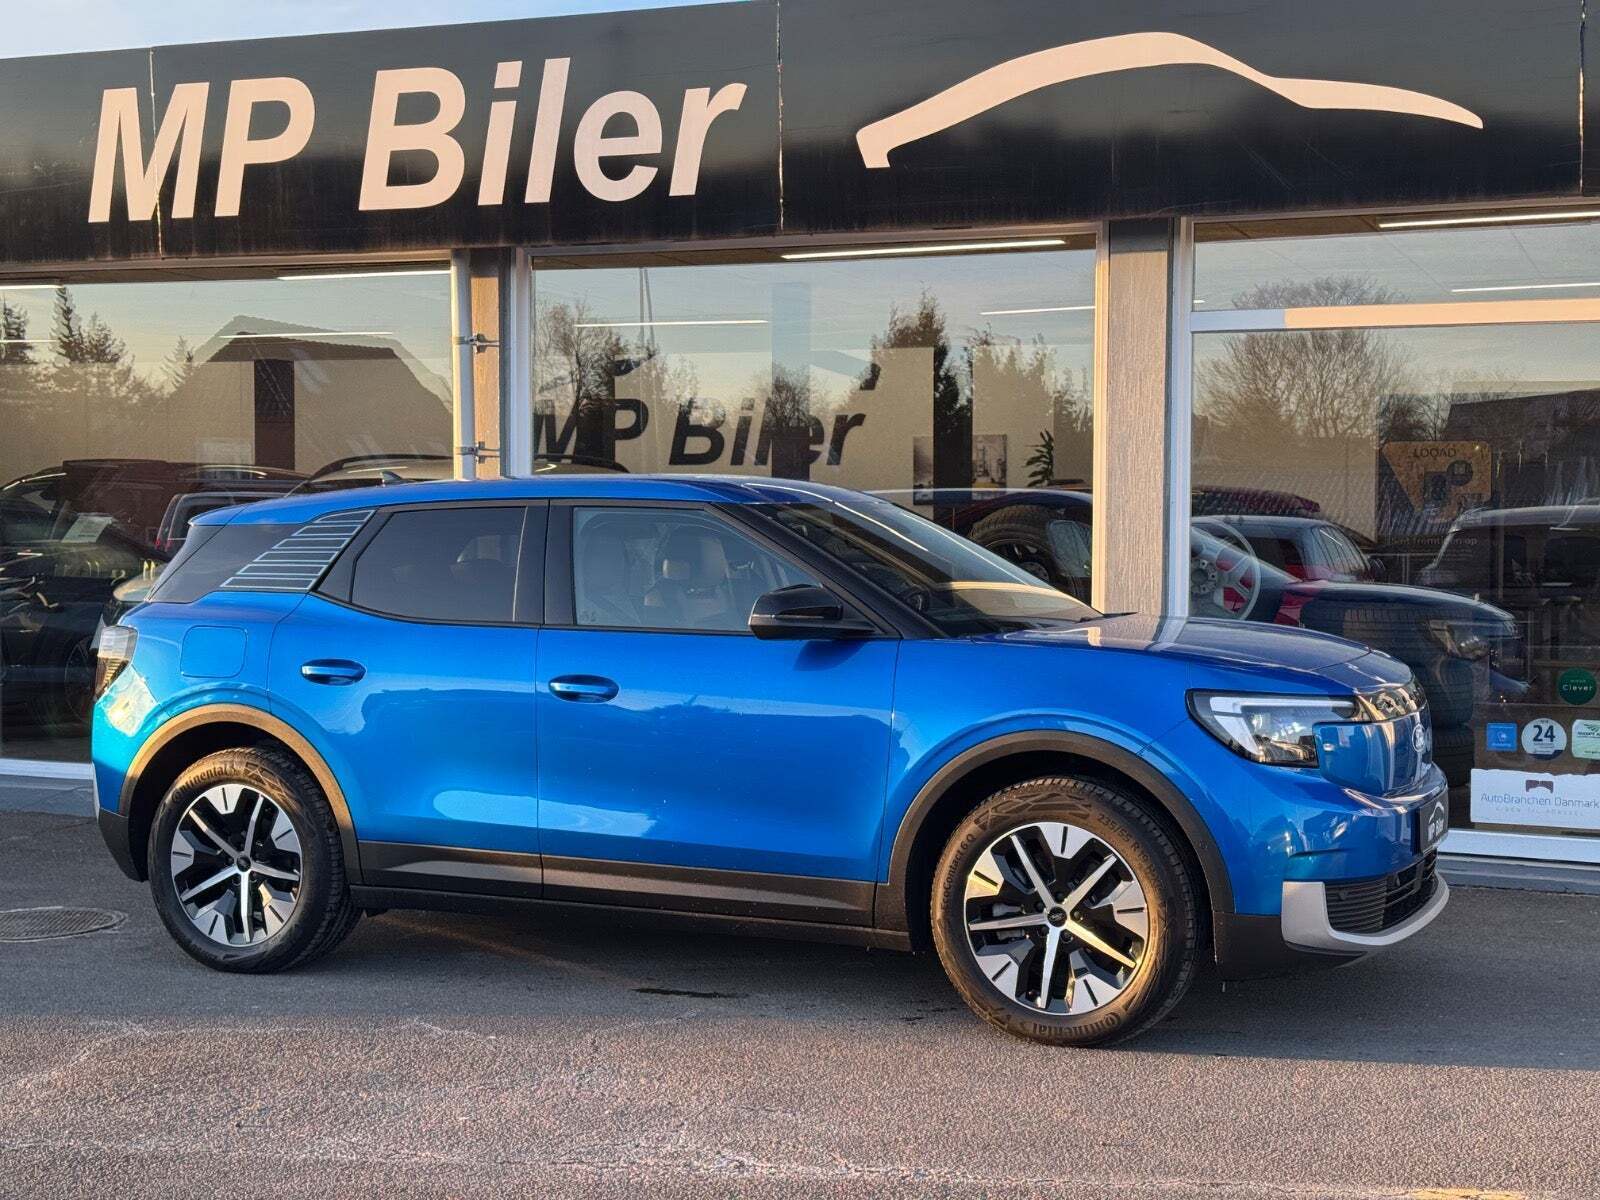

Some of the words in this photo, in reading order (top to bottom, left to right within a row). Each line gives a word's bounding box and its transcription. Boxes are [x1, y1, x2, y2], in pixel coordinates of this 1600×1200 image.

[87, 76, 316, 223] MP
[358, 57, 747, 211] Biler
[1562, 683, 1593, 692] Clever
[1532, 724, 1556, 743] 24
[1480, 793, 1551, 807] AutoBranchen
